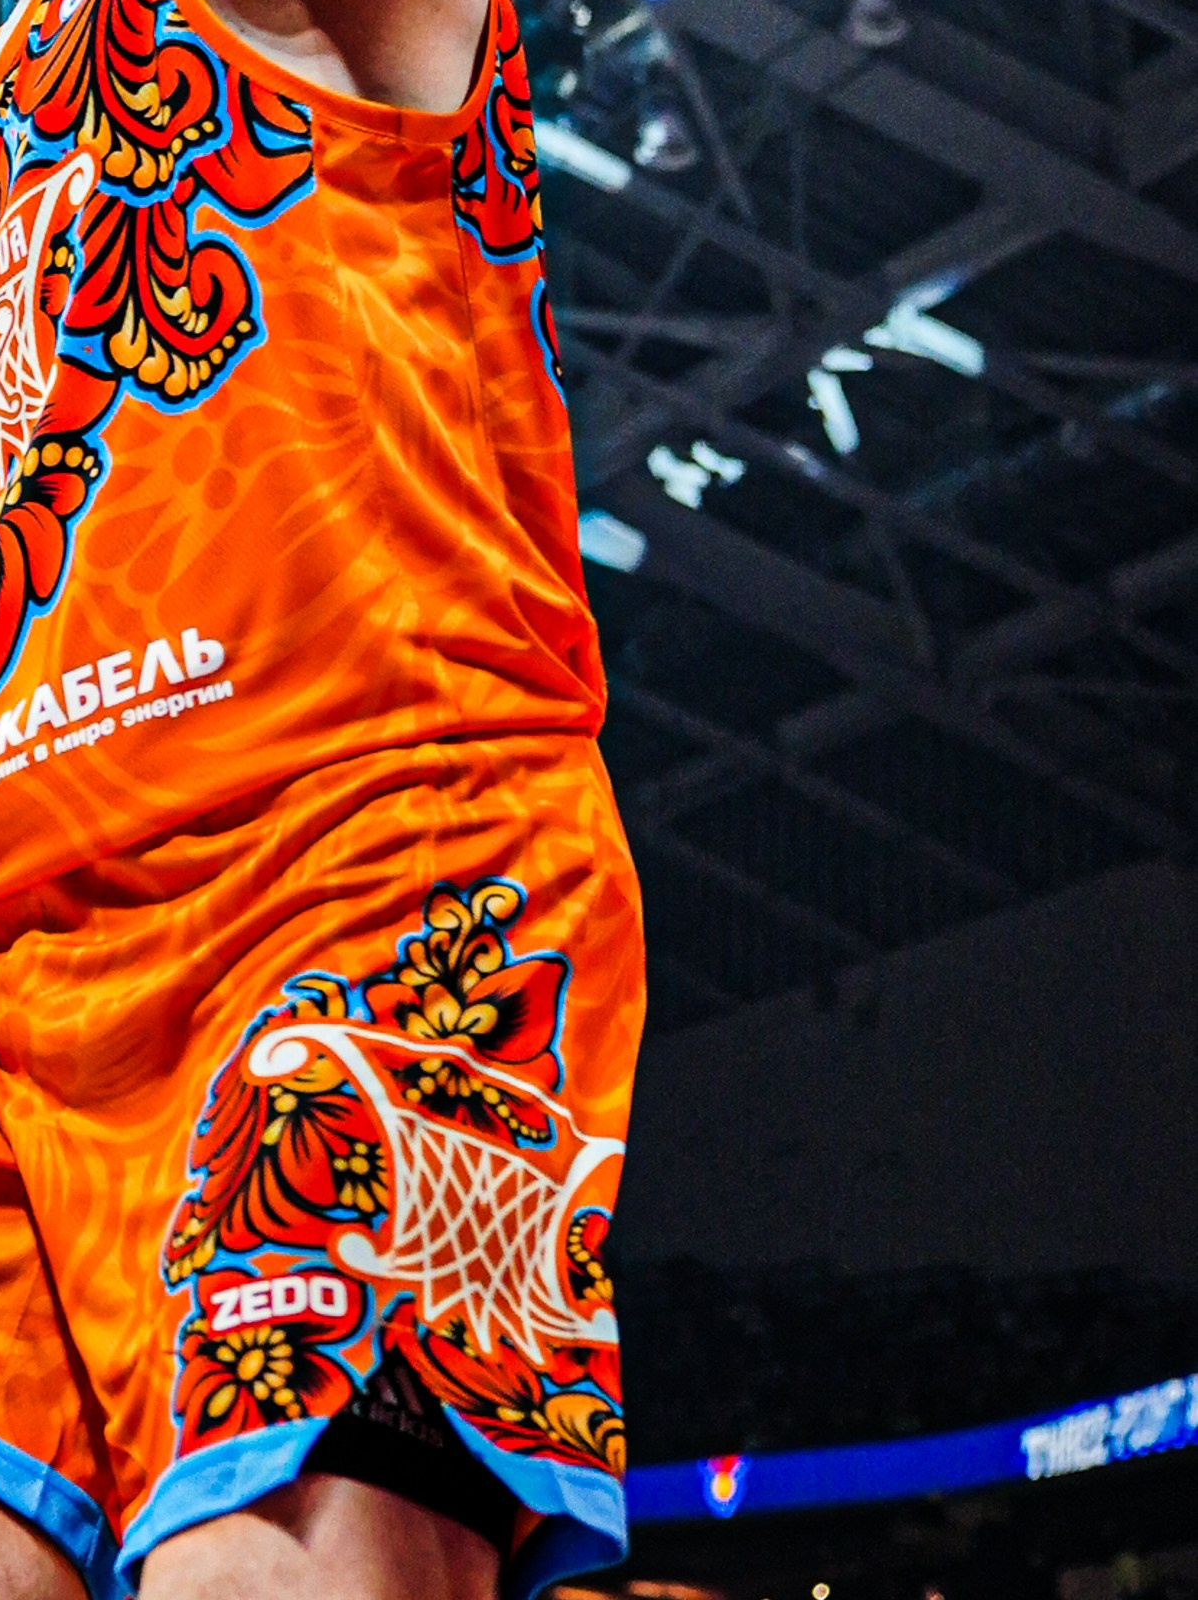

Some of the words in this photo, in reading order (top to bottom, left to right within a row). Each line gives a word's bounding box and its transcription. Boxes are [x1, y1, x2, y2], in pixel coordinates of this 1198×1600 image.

[33, 743, 49, 763] в
[53, 717, 116, 755] мире
[120, 680, 234, 728] энергии
[210, 1275, 348, 1332] ZEDO
